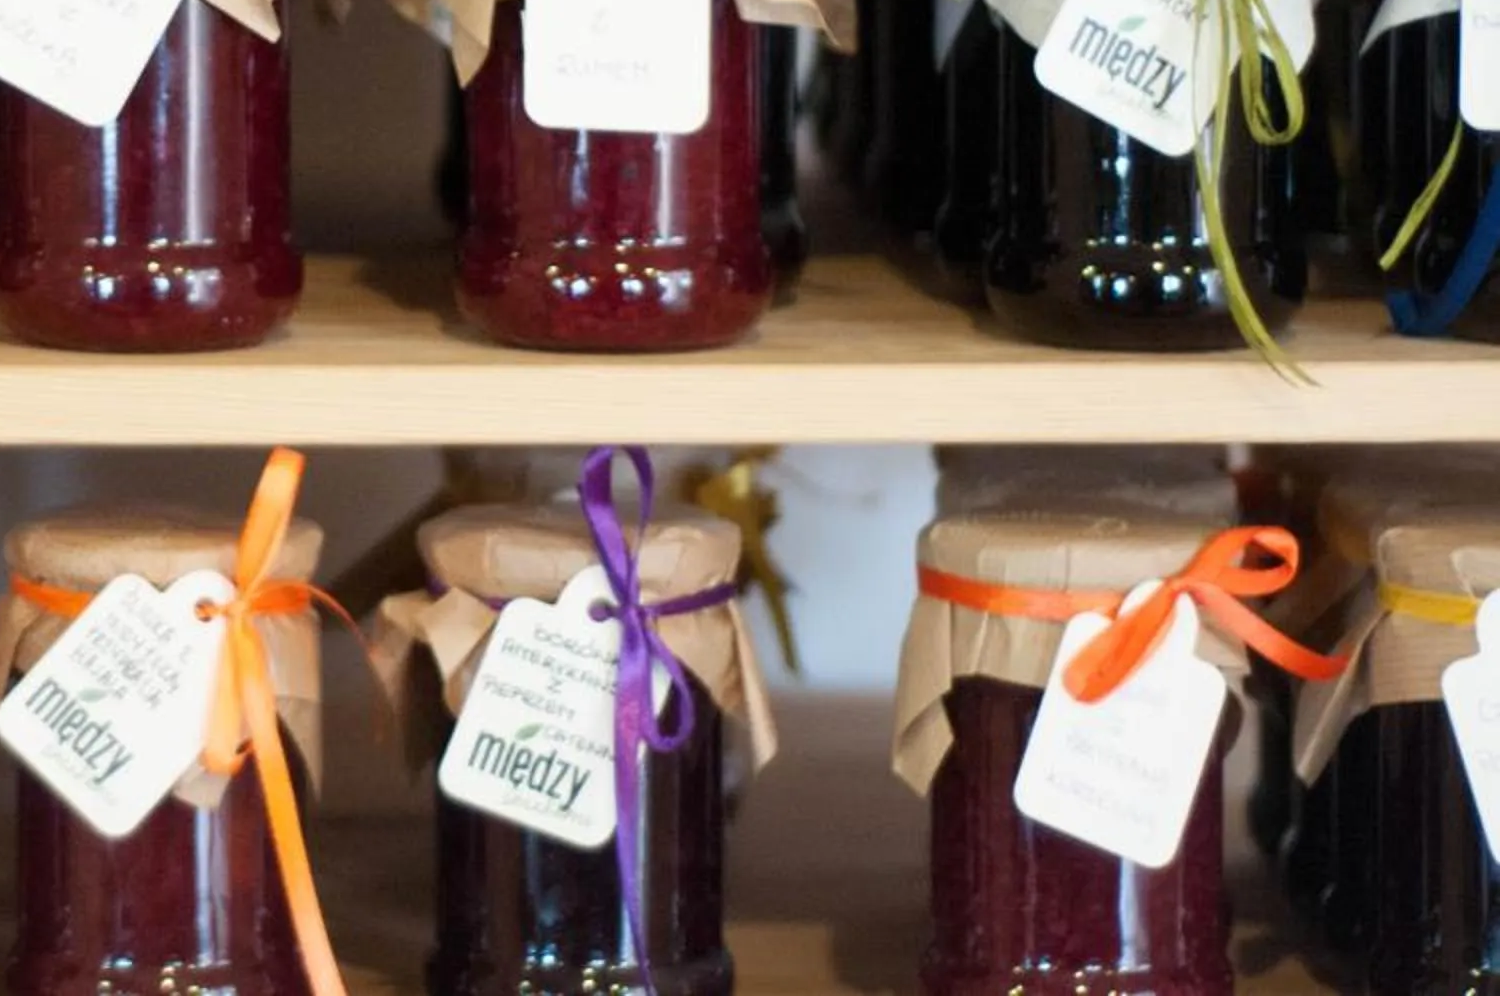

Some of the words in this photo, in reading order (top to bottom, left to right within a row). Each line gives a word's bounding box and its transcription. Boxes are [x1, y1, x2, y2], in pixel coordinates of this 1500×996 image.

[1069, 16, 1187, 110] między
[24, 676, 134, 786] między
[468, 731, 592, 812] między
